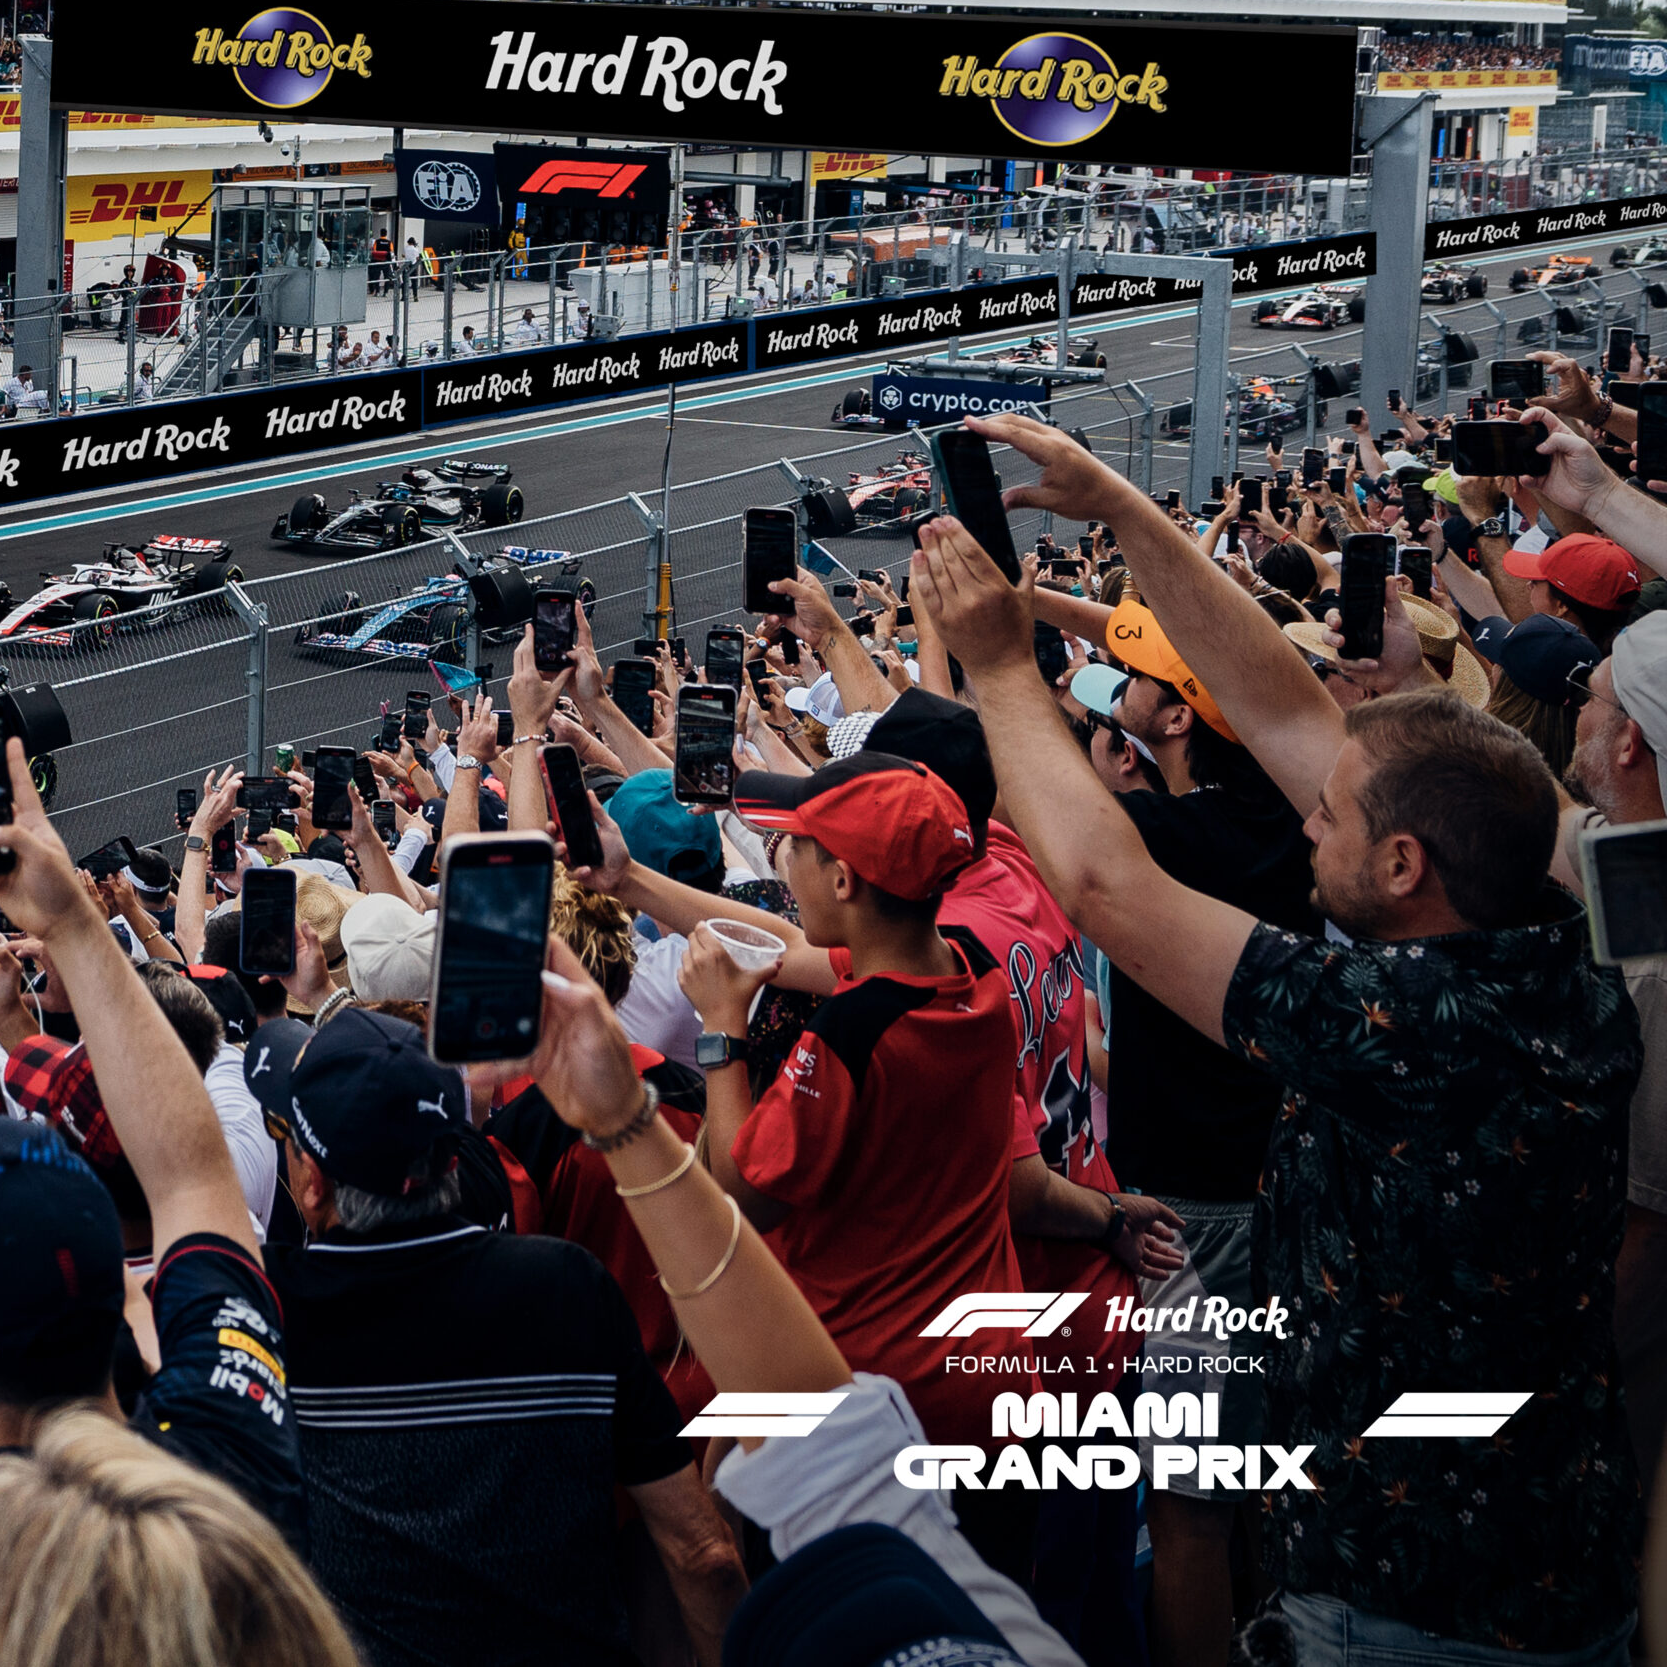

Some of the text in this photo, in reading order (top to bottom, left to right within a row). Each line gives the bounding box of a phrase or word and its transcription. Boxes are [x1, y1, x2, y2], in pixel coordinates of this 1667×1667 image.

[193, 28, 373, 79] Hard Rock
[486, 31, 788, 116] Hard Rock
[940, 55, 1168, 113] Hard Rock
[417, 170, 476, 201] FIA
[519, 159, 648, 199] F1
[90, 180, 189, 223] DHL
[1437, 222, 1520, 248] Hard Rock
[1537, 210, 1606, 233] Hard Rock
[1277, 246, 1365, 276] Hard Rock
[980, 289, 1056, 319] Hard Rock
[1077, 277, 1156, 304] Hard Rock
[768, 319, 858, 353] Hard Rock
[878, 304, 961, 335] Hard Rock
[553, 353, 640, 387] Hard Rock
[659, 337, 738, 370] Hard Rock
[436, 369, 532, 406] Hard Rock
[266, 390, 405, 438] Hard Rock
[62, 417, 230, 471] Hard Rock
[1115, 623, 1142, 640] 3
[209, 1364, 285, 1426] Mobil
